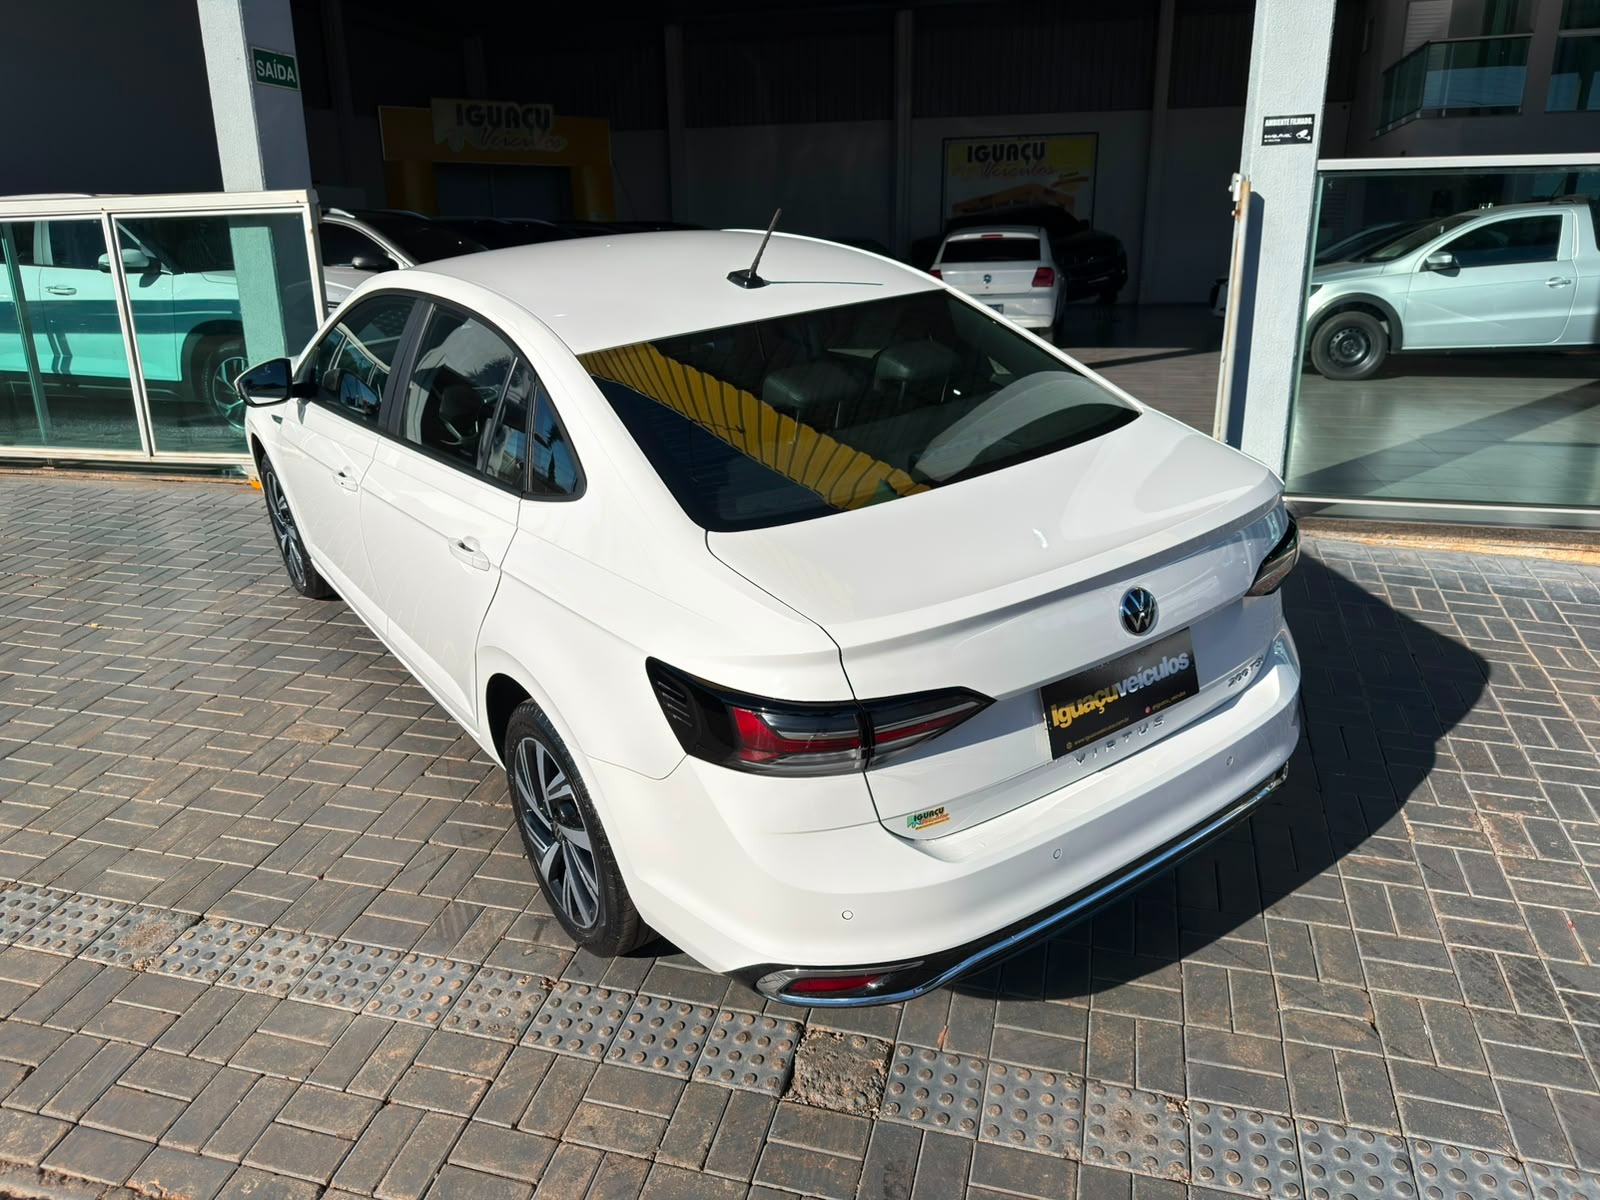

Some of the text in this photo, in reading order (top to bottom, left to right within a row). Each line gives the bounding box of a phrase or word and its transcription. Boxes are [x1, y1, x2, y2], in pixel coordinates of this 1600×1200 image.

[256, 58, 296, 83] SAÍDA
[455, 103, 552, 137] IGUAÇU
[967, 141, 1046, 166] IGUAÇU
[1073, 715, 1165, 766] VIRTUS
[913, 806, 945, 822] IGUAÇU
